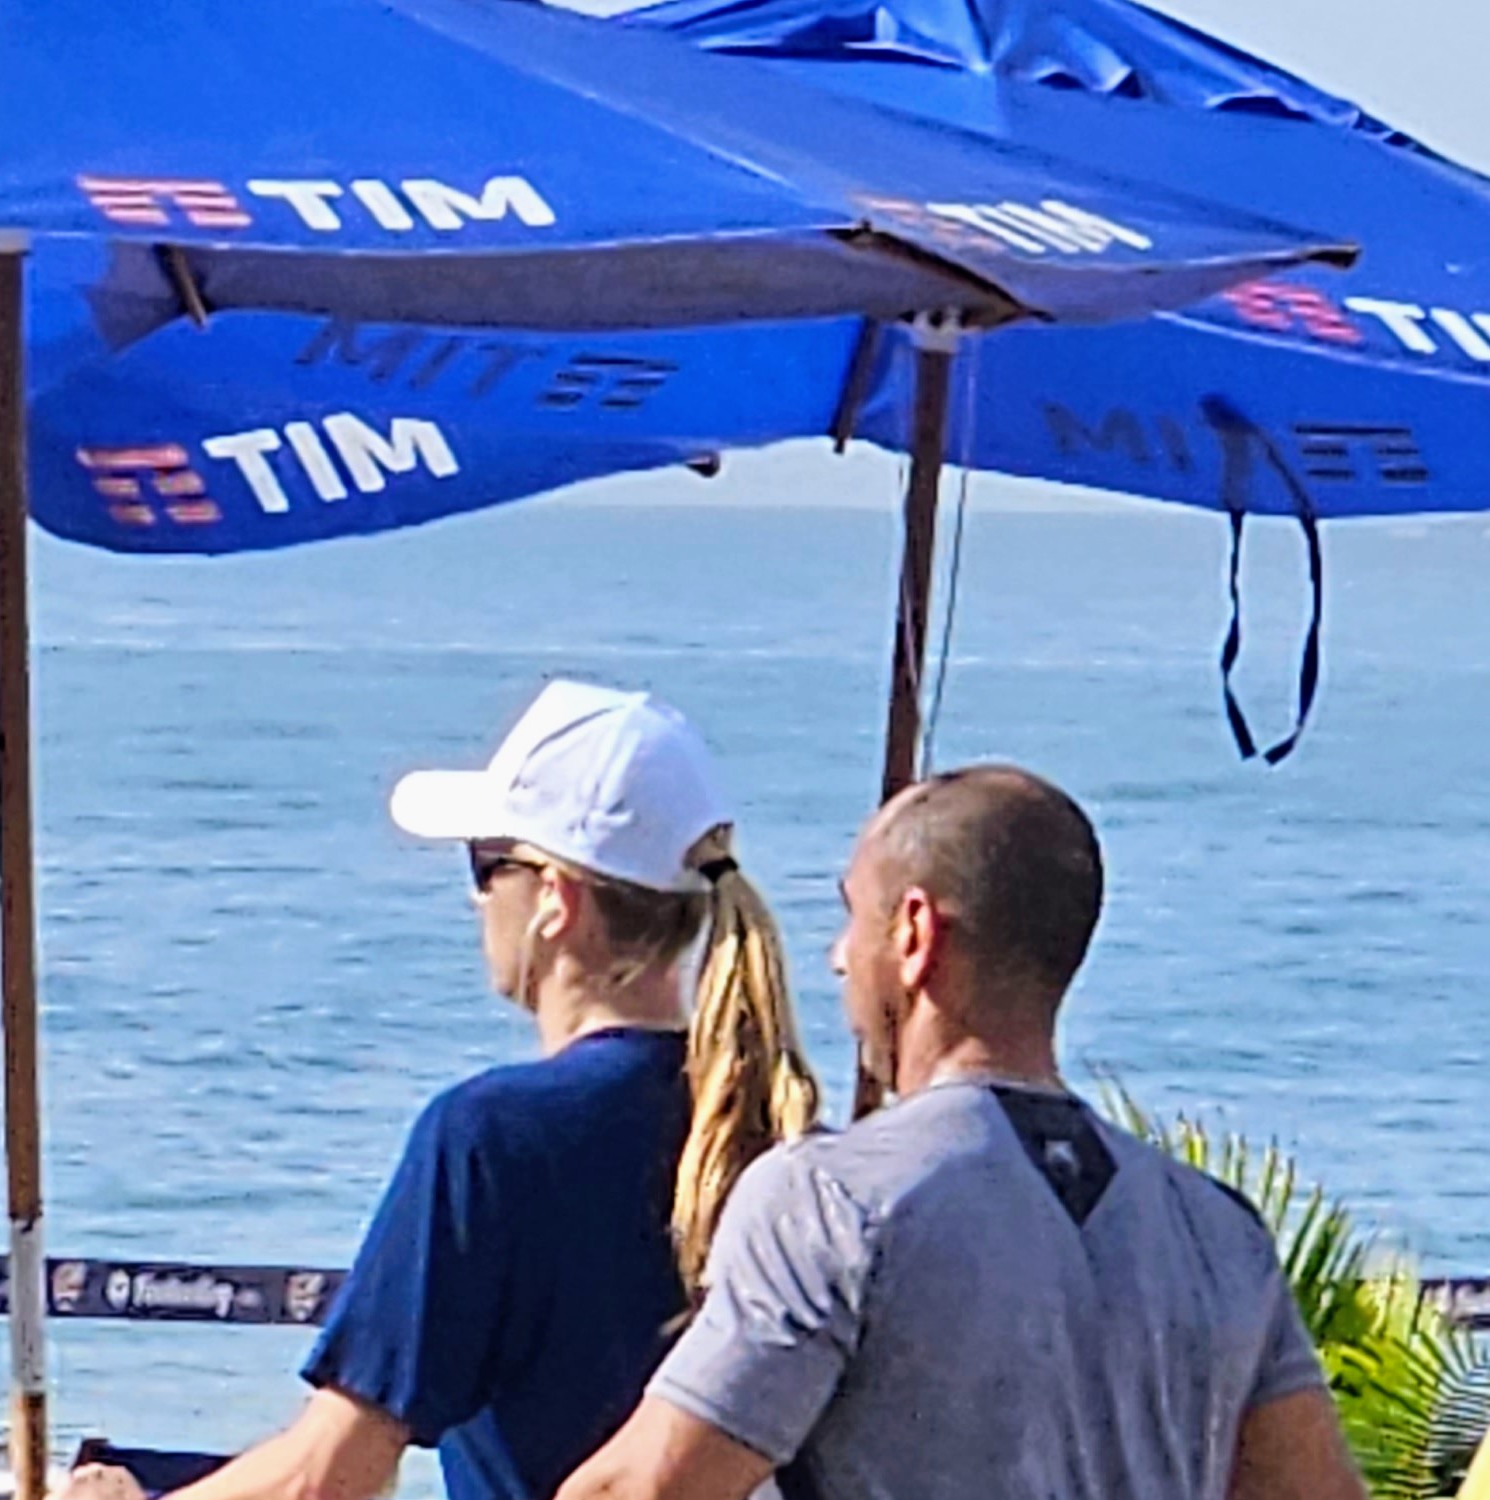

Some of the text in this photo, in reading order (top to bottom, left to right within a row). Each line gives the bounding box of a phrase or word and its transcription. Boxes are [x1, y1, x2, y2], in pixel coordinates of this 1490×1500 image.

[246, 175, 557, 231] TIM
[926, 199, 1154, 254] TIM
[1343, 296, 1490, 363] TI
[201, 411, 460, 513] TIM
